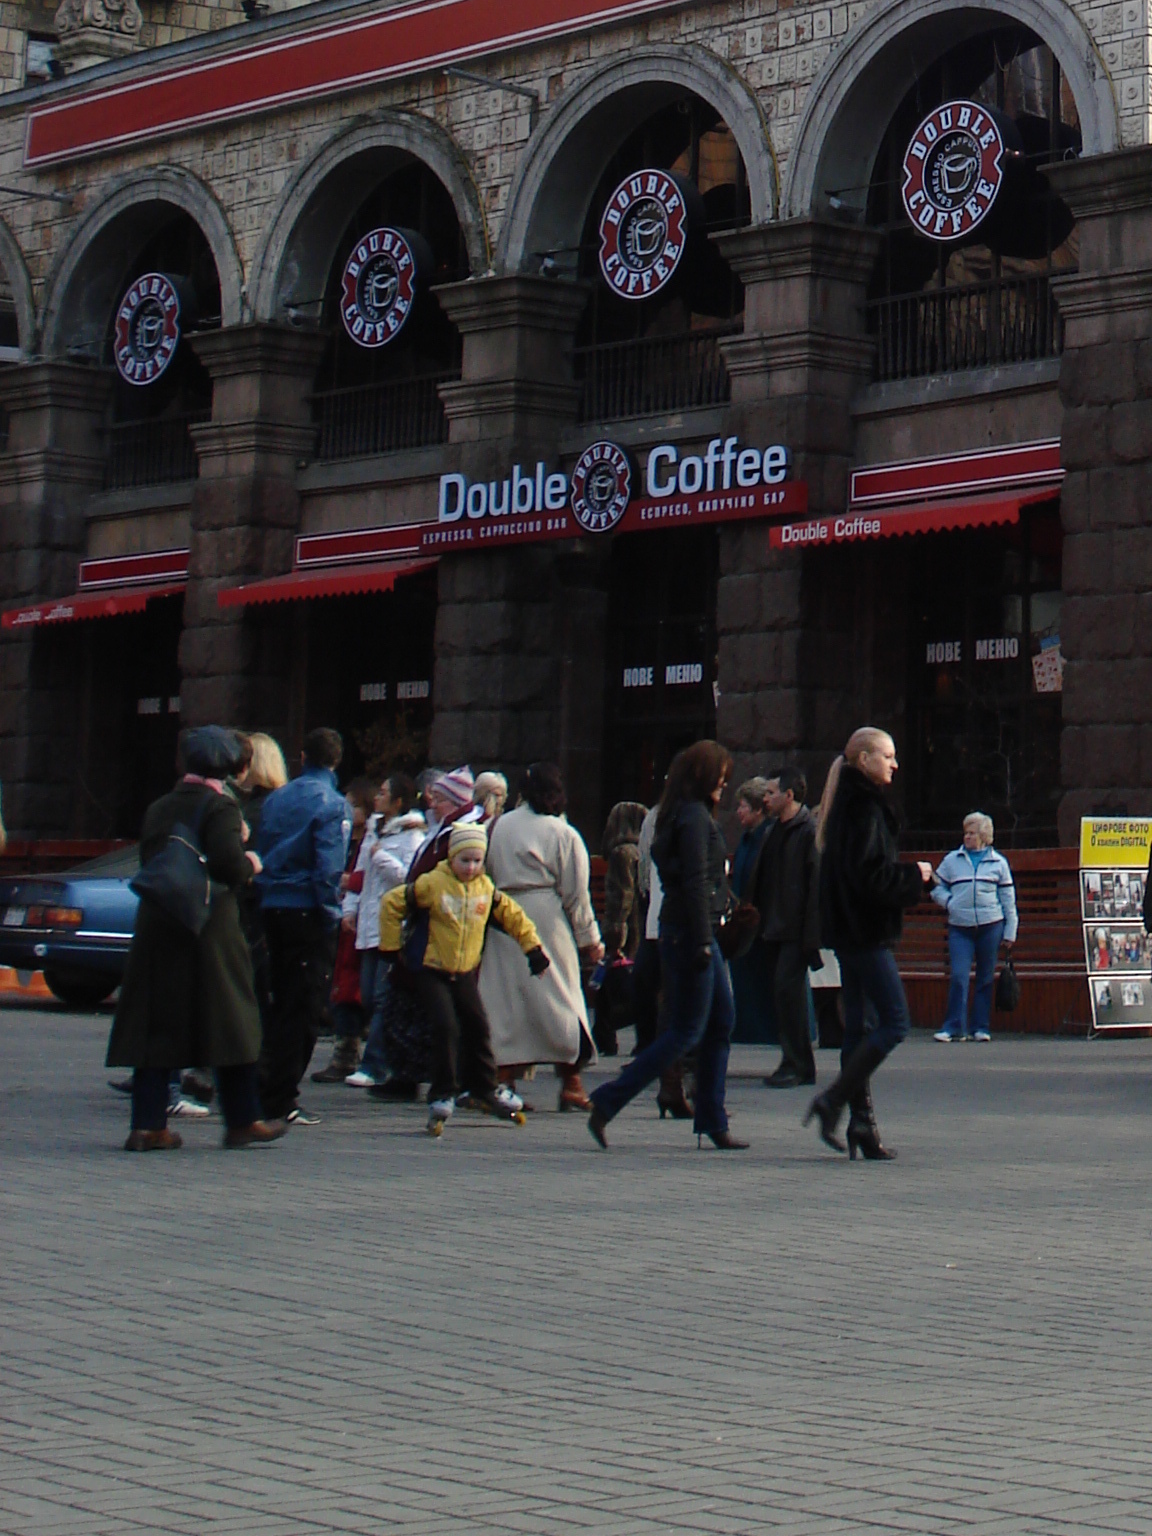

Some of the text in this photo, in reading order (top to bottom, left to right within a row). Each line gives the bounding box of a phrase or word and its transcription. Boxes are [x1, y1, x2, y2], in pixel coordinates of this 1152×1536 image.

[911, 107, 996, 160] DOUBLE
[606, 175, 680, 225] DOUBLE
[909, 178, 995, 233] COFFEE
[347, 233, 411, 277] DOUBLE
[605, 241, 680, 293] COFFEE
[120, 278, 175, 320] DOUBLE
[344, 296, 408, 342] COFFEE
[119, 334, 174, 379] COFFEE
[438, 461, 568, 522] Double
[646, 436, 788, 498] Coffee
[576, 446, 627, 479] DOUBLE
[574, 493, 627, 528] COFFEE
[763, 491, 786, 505] БАР
[480, 520, 542, 538] CAPPUCCINO
[547, 517, 567, 531] BAR
[781, 517, 881, 543] Double Coffee
[926, 637, 1019, 664] НОВЕ МЕНЮ
[623, 663, 703, 687] НОВЕ МЕНЮ
[1092, 823, 1149, 834] ЦИФРОВЕ ФОТО
[1121, 836, 1147, 847] DIGITAL
